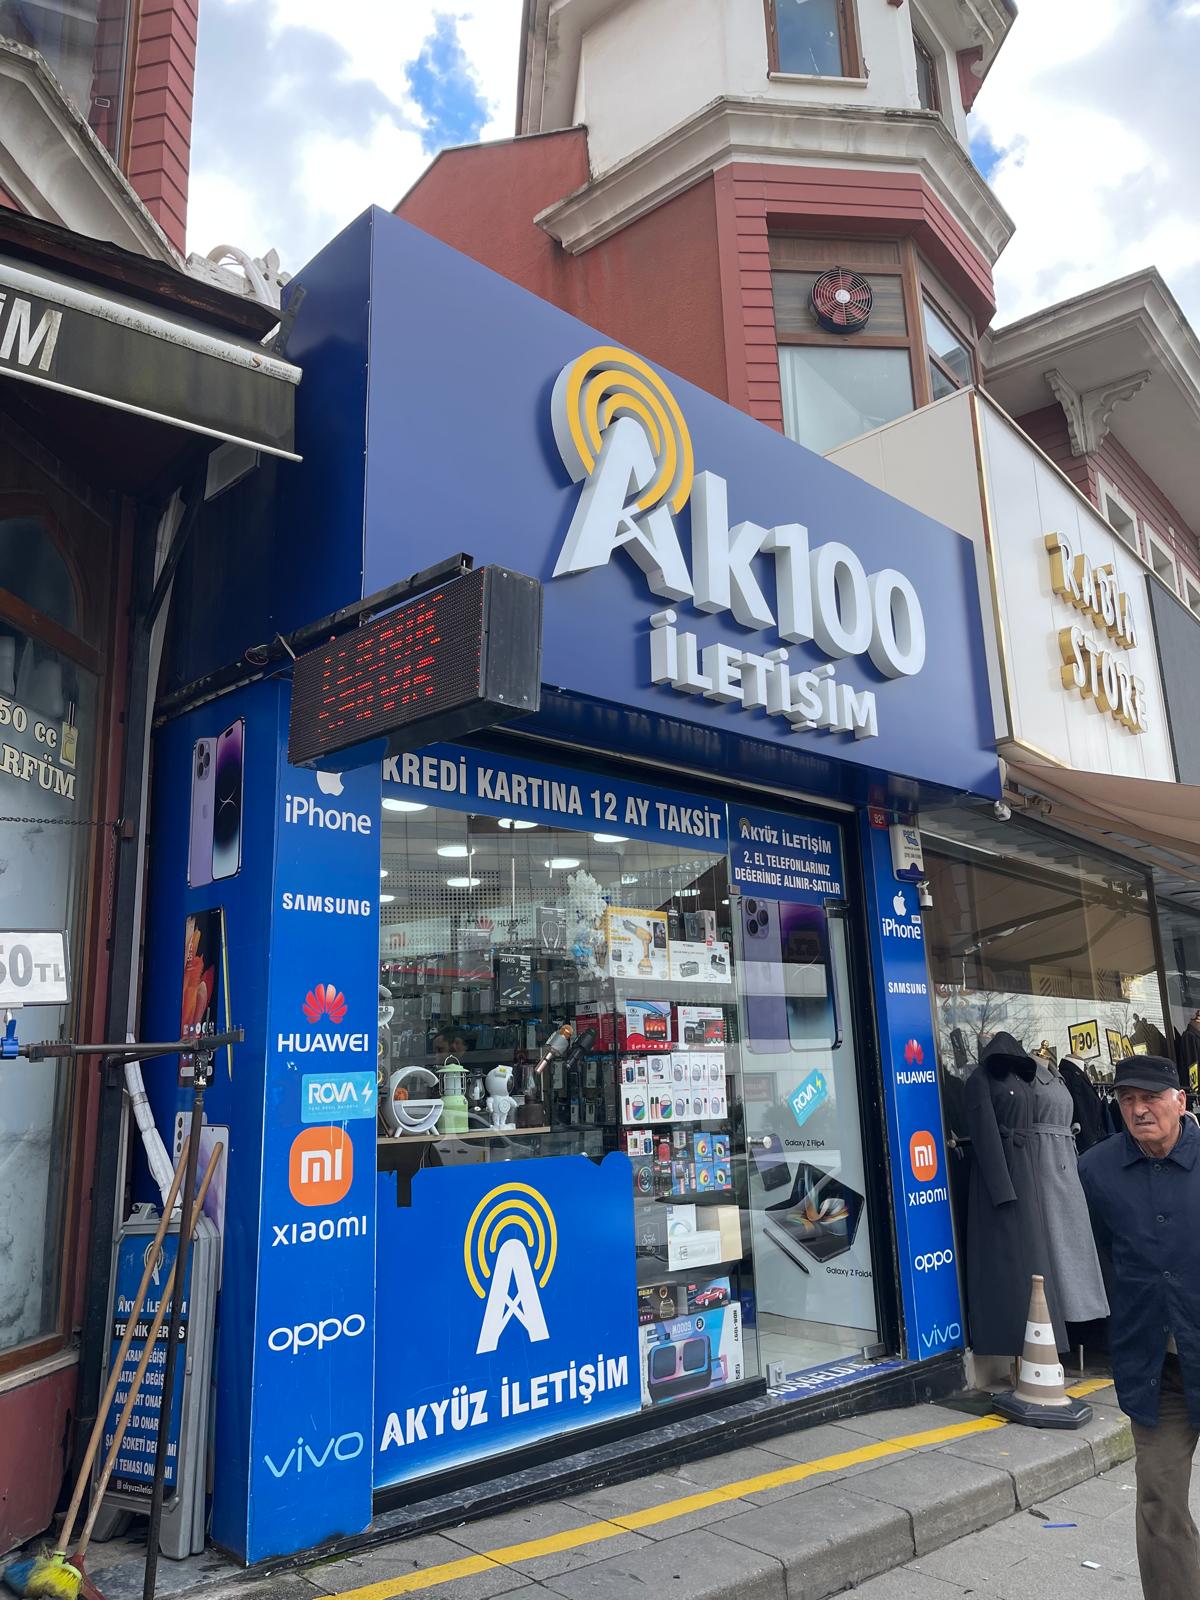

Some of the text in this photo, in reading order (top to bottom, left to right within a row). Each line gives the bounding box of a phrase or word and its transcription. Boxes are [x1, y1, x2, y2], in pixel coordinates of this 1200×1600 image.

[650, 608, 879, 740] İLETİŞİM
[1058, 625, 1148, 735] STORE
[33, 721, 57, 748] cc
[0, 743, 76, 800] RFÜM
[383, 751, 721, 840] KREDİ KARTINA 12 AY TAKSİT
[285, 794, 372, 835] iPhone
[741, 824, 832, 855] AKYÜZ İLETİŞİM
[743, 850, 831, 877] 2. EL TELEFONLARINIZ
[734, 866, 841, 895] DEĞERİNDE ALINIR-SATILIR
[282, 892, 371, 917] SAMSUNG
[881, 918, 921, 939] iPhone
[888, 980, 927, 995] SAMSUNG
[277, 1032, 370, 1054] HUAWEI
[896, 1070, 936, 1085] HUAWEI
[308, 1082, 359, 1105] ROVA
[792, 1083, 817, 1114] ROVA
[784, 1139, 806, 1148] Galaxy
[826, 1267, 849, 1277] Galaxy
[914, 1249, 953, 1273] oppo
[115, 1321, 149, 1337] TENİK
[267, 1314, 366, 1355] oppo
[921, 1322, 961, 1349] vivo
[379, 1353, 629, 1452] AKYÜZ İLETİŞİM
[264, 1431, 364, 1478] vivo
